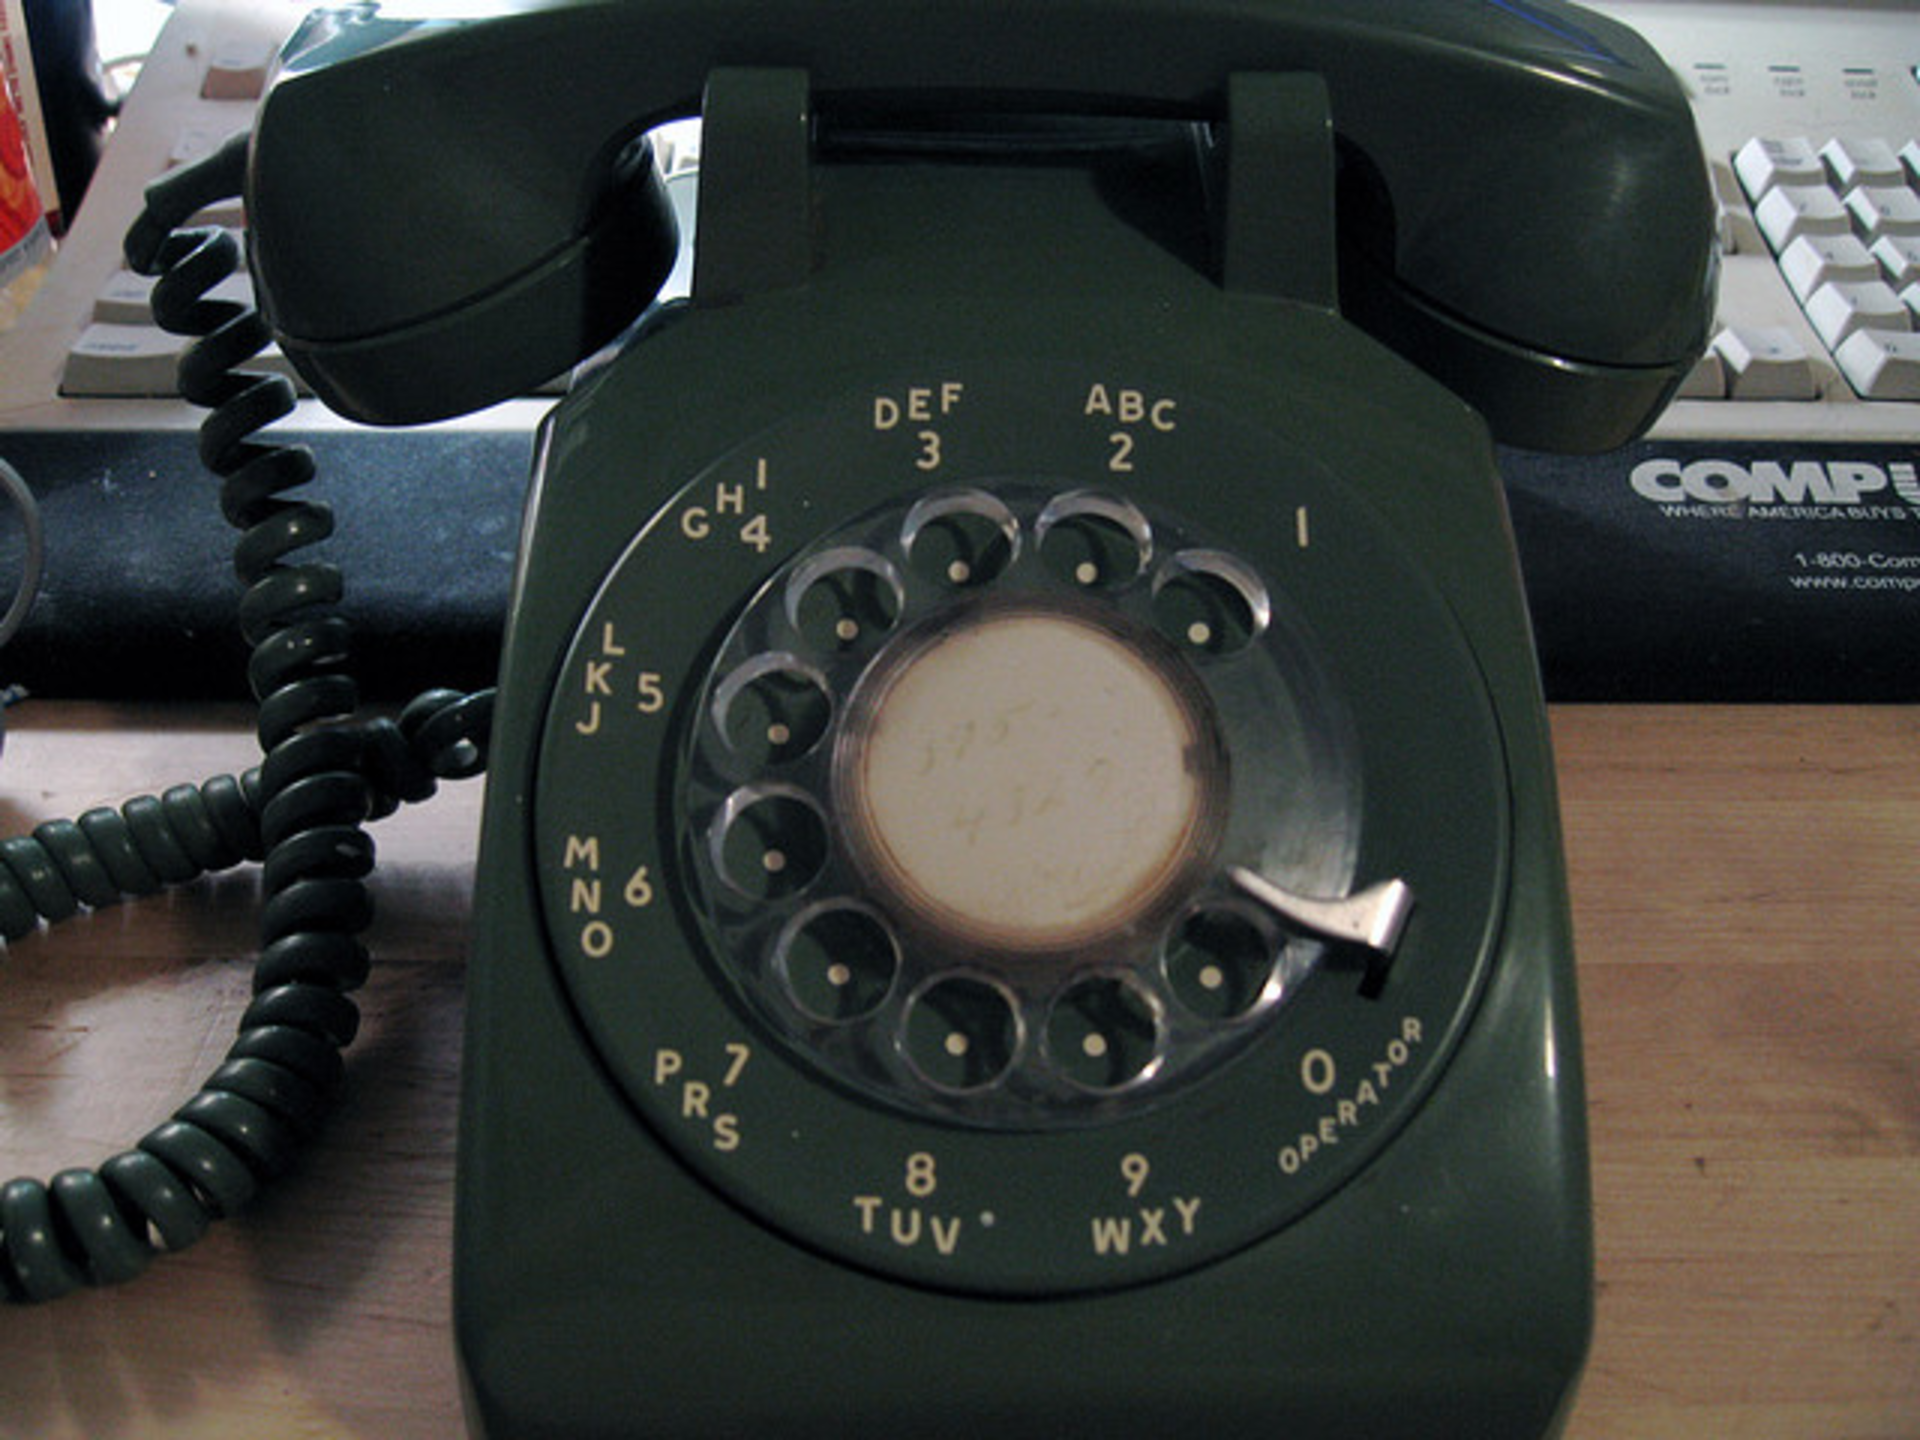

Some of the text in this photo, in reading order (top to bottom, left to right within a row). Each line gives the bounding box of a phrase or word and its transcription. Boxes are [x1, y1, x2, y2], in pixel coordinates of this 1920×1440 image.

[873, 382, 963, 431] DEF
[1084, 383, 1177, 432] ABC
[914, 430, 941, 470] 3
[1108, 431, 1134, 471] 2
[739, 514, 772, 553] 4
[1659, 503, 1742, 518] WHERE
[1748, 504, 1845, 520] AMERICA
[1849, 505, 1906, 520] BUYS
[637, 672, 664, 713] 5
[624, 865, 653, 907] 6
[723, 1043, 750, 1086] 7
[1278, 1016, 1423, 1175] OPERATOR
[904, 1151, 937, 1197] 8
[1120, 1152, 1150, 1197] 9
[853, 1196, 961, 1255] TUV
[1091, 1197, 1201, 1256] WXY
